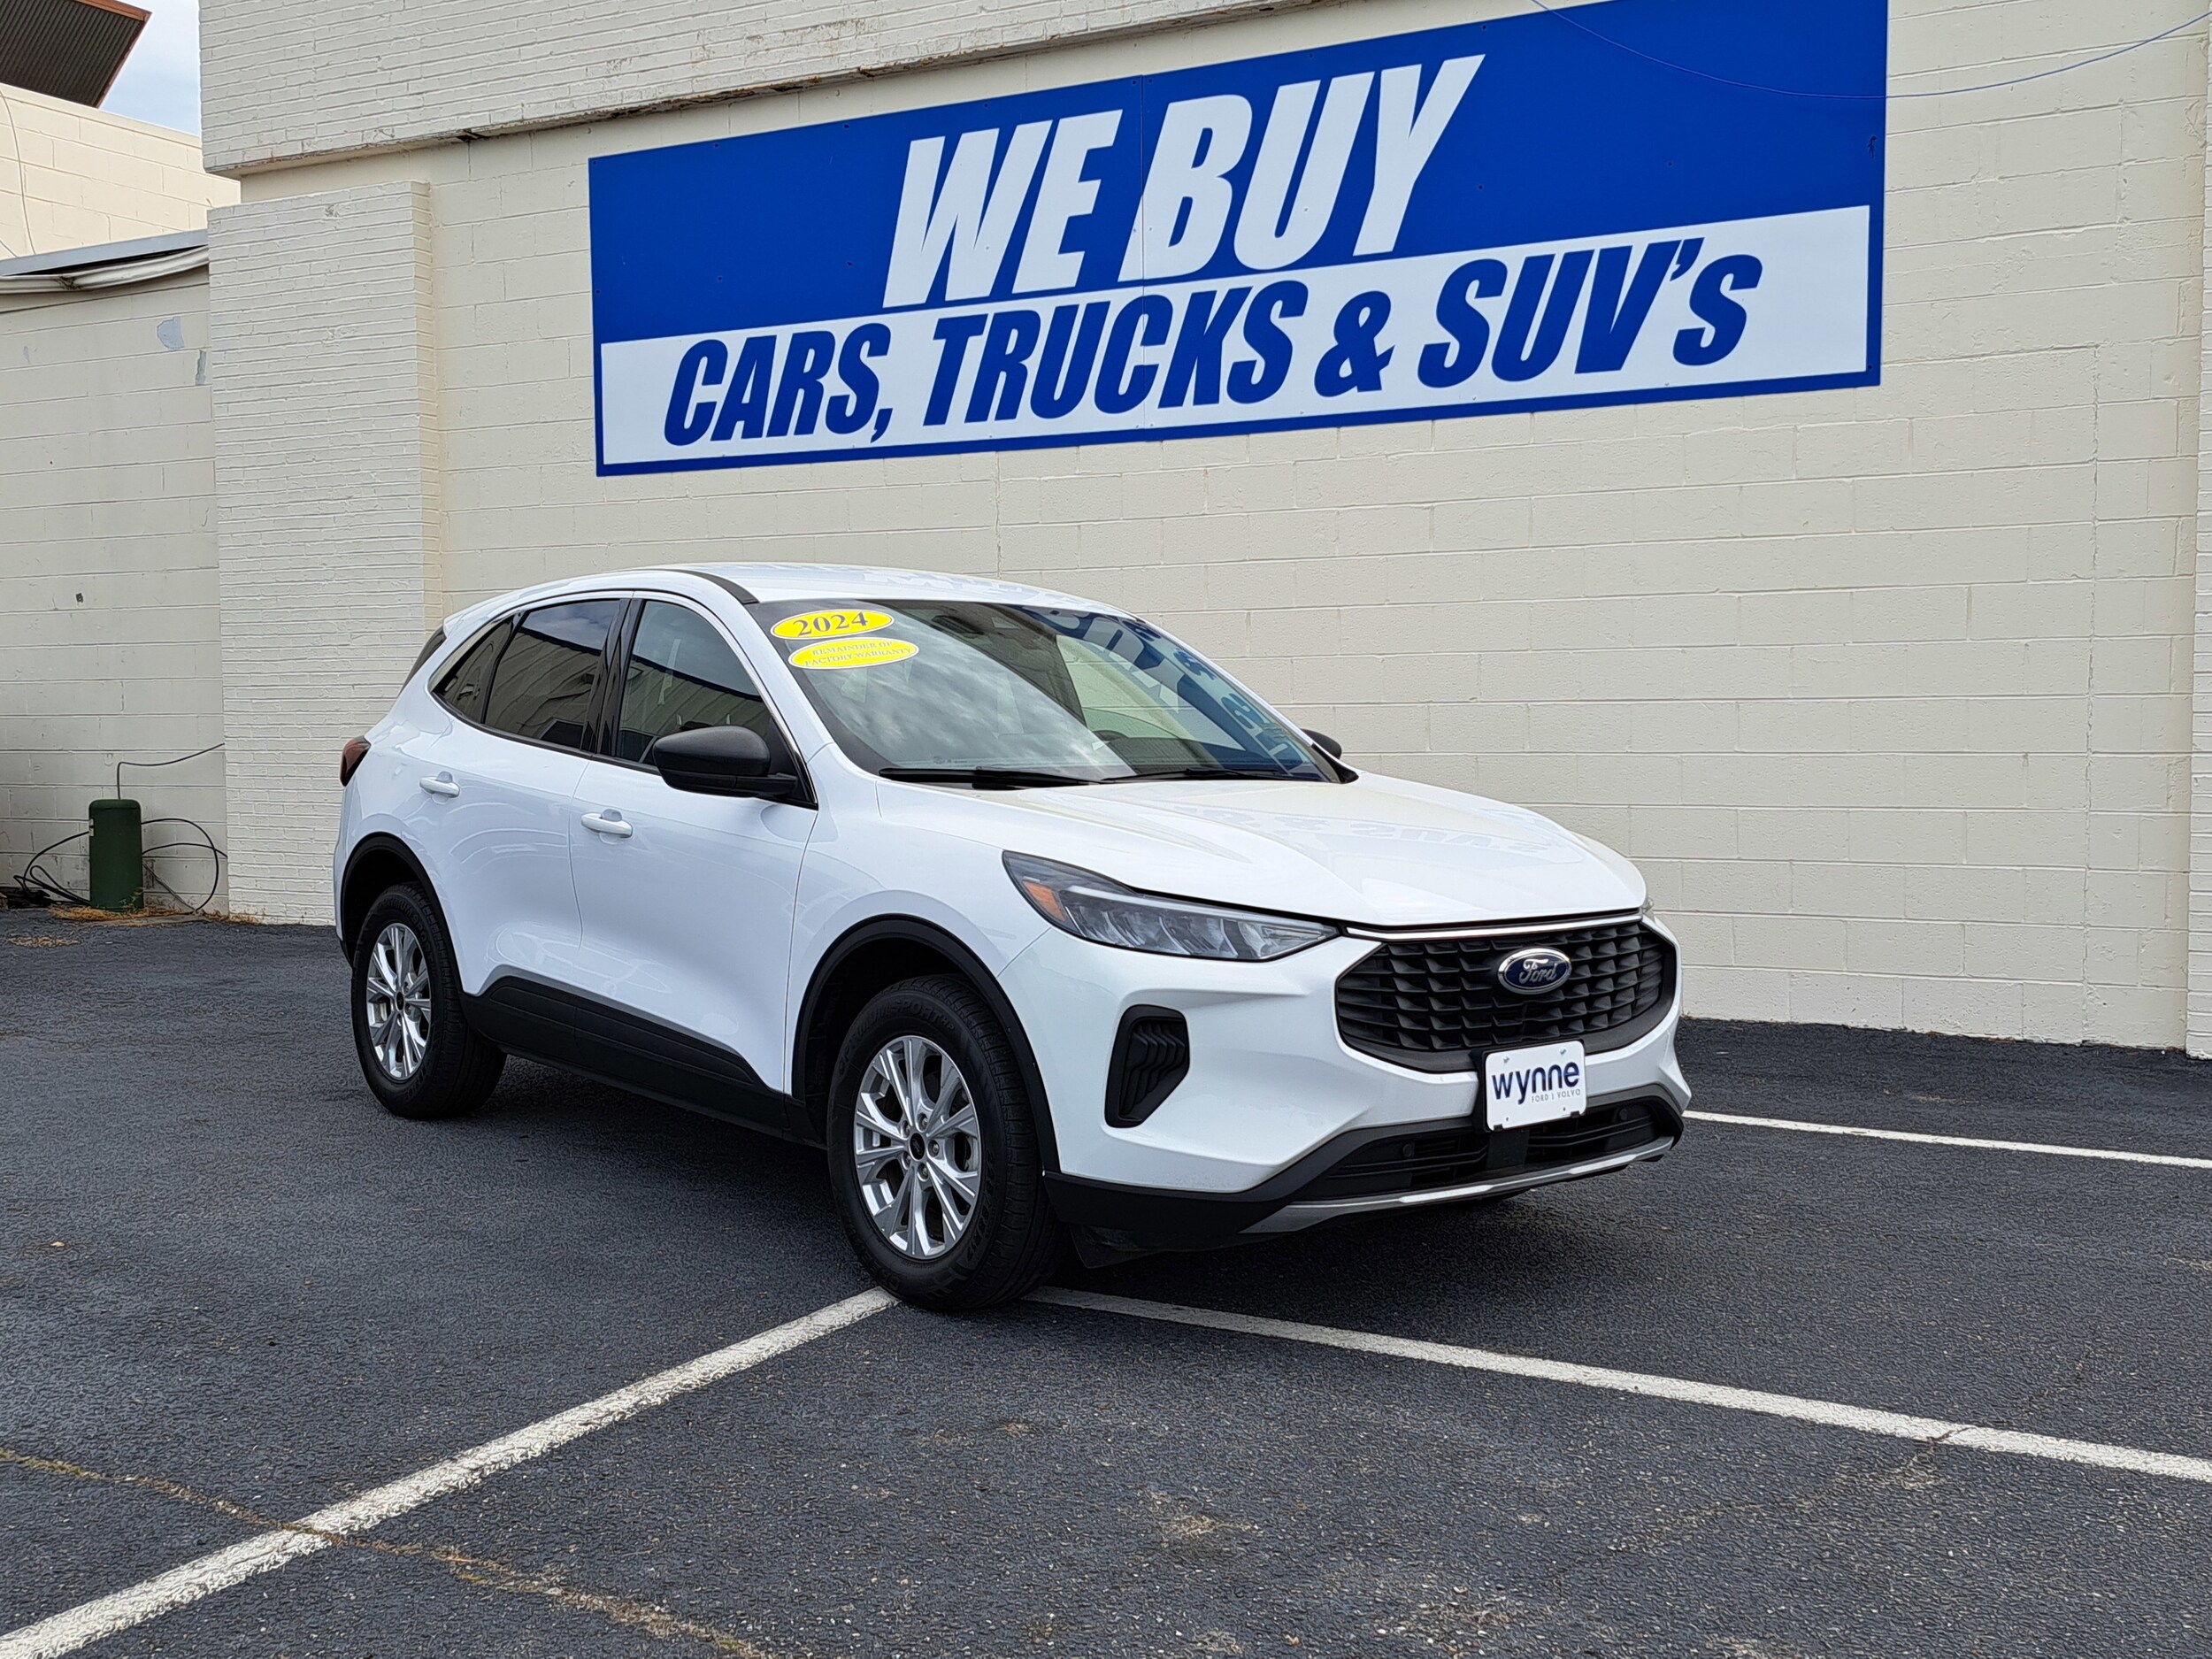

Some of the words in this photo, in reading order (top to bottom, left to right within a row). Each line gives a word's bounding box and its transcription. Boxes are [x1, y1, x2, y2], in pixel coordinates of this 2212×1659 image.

[883, 110, 1122, 307] WE
[1118, 55, 1485, 281] BUY
[664, 323, 892, 446] CARS,
[924, 280, 1308, 426] TRUCKS
[1315, 291, 1394, 396] &
[793, 612, 868, 636] 2024
[804, 653, 853, 666] FACTORY
[855, 648, 911, 658] WARRANTY
[811, 642, 877, 657] REMAINDER
[1518, 959, 1557, 984] Ford
[1492, 1062, 1580, 1105] wynne
[1531, 1094, 1548, 1103] FORD
[1557, 1088, 1581, 1099] VOLVO
